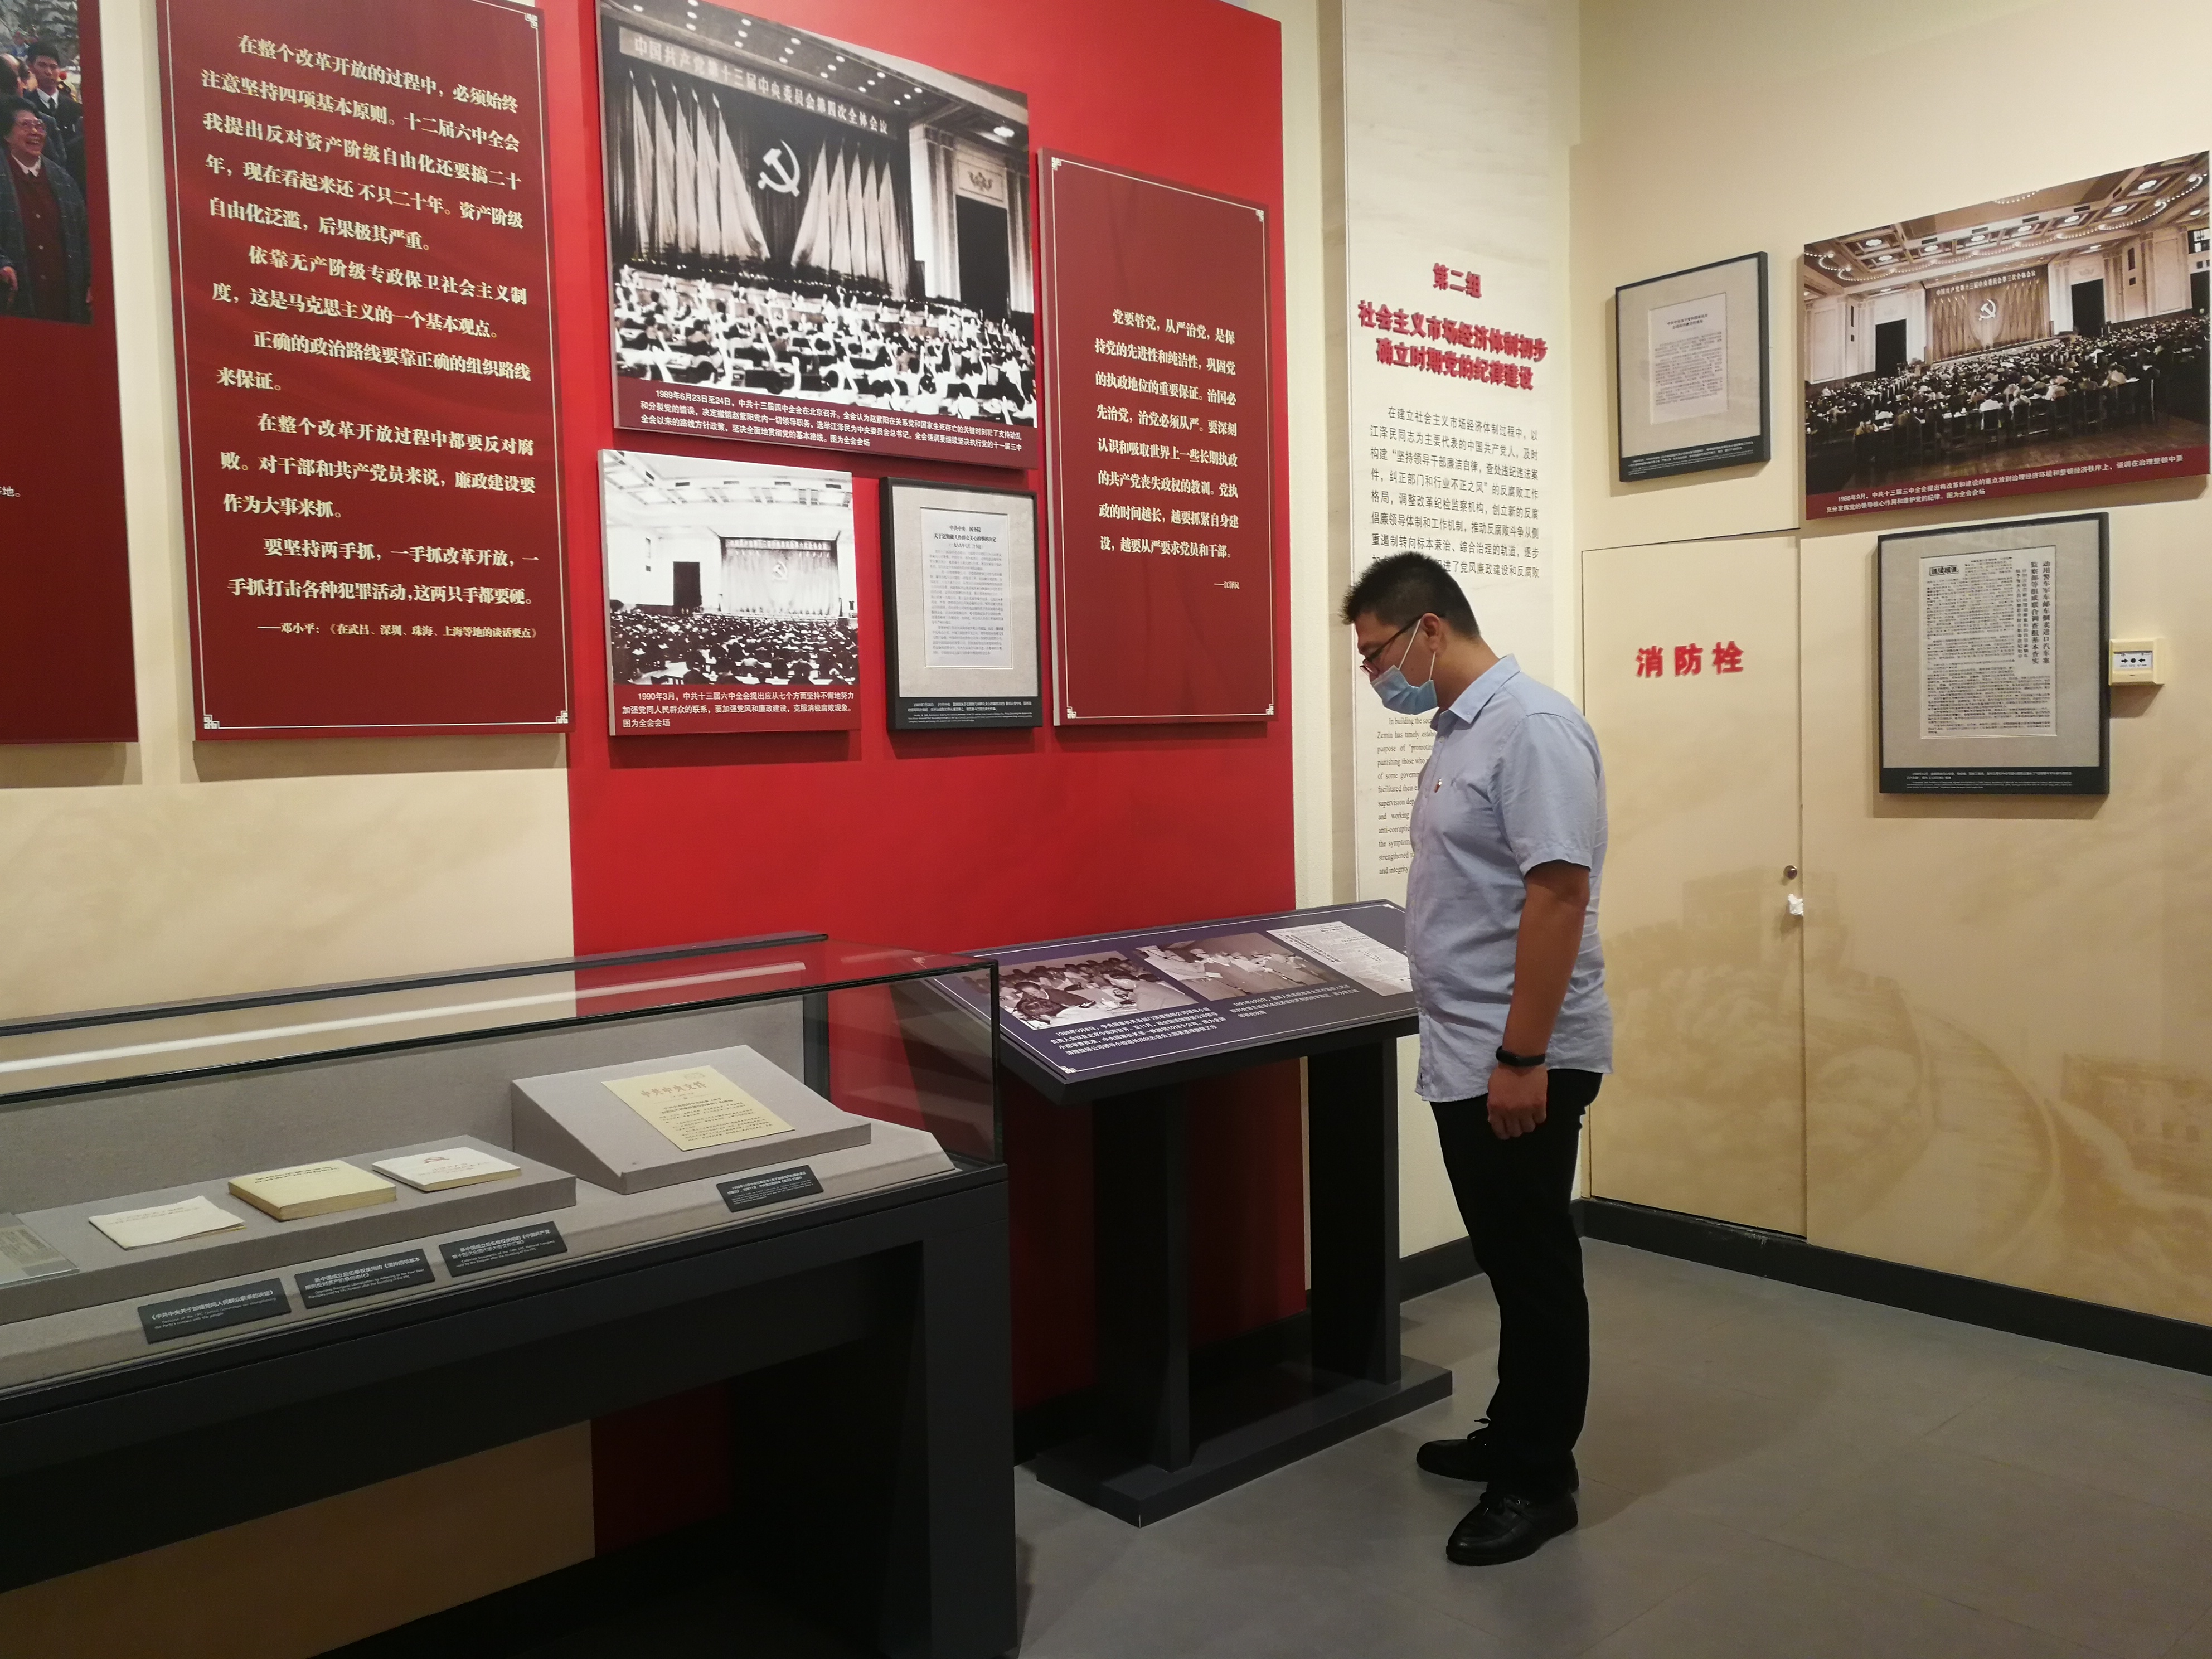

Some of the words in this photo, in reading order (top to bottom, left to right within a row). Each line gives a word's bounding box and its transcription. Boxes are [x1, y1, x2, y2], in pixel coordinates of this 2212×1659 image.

[237, 34, 518, 114] 在整个改革开放的过程中，必须始终
[201, 70, 520, 153] 注意坚持四项基本原则。十二届六中全会
[203, 112, 522, 190] 我提出反对资产阶级自由化还要搞二十
[210, 197, 429, 251] 自由化泛滥，后果极其严重。
[248, 245, 527, 305] 依靠无产阶级专政保卫社会主义制
[1432, 263, 1482, 298] 第二组
[212, 283, 497, 338] 度，这是马克思主义的一个基本观点。
[1112, 309, 1235, 345] 党要管党，从严治党，是保
[1357, 299, 1548, 362] 社会主义市场经济体制初步
[253, 331, 531, 382] 正确的政治路线要靠正确的组织路线
[1094, 338, 1236, 376] 持党的先进性和纯洁性，巩固党
[1376, 337, 1534, 391] 确立时期党的纪律建设
[216, 368, 282, 391] 来保证。
[1095, 371, 1236, 406] 的执政地位的重要保证。治国必
[257, 413, 533, 456] 在整个改革开放过程中都要反对腐
[1097, 404, 1237, 437] 先治党，治党必须从严。要深刻
[1388, 406, 1538, 442] 在建立社会主义市场经济体制过程中，以
[1098, 437, 1238, 468] 认识和吸取世界上一些长期执政
[1370, 425, 1538, 461] 江泽民同志为主要代表的中国共产党人，及时
[220, 452, 536, 494] 败。对干部和共产党员来说，廉政建设要
[1098, 470, 1239, 498] 的共产党丧失政权的教训。党执
[0, 486, 21, 497] 地。
[224, 494, 342, 518] 作为大事来抓。
[1371, 489, 1539, 520] 格局，调整改革纪检监察机构，创立新的反腐
[1099, 503, 1239, 529] 政的时间越长，越要抓紧自身建
[264, 537, 540, 567] 要坚持两手抓，一手抓改革开放，一
[1100, 536, 1231, 558] 设，越要从严要求党员和干部。
[1636, 641, 1743, 678] 消防栓
[623, 719, 670, 727] 图为全会会场
[1395, 717, 1414, 726] building
[1377, 758, 1400, 768] punishing
[1378, 798, 1405, 808] supervision
[1391, 812, 1409, 820] working
[1379, 852, 1409, 861] strengthened
